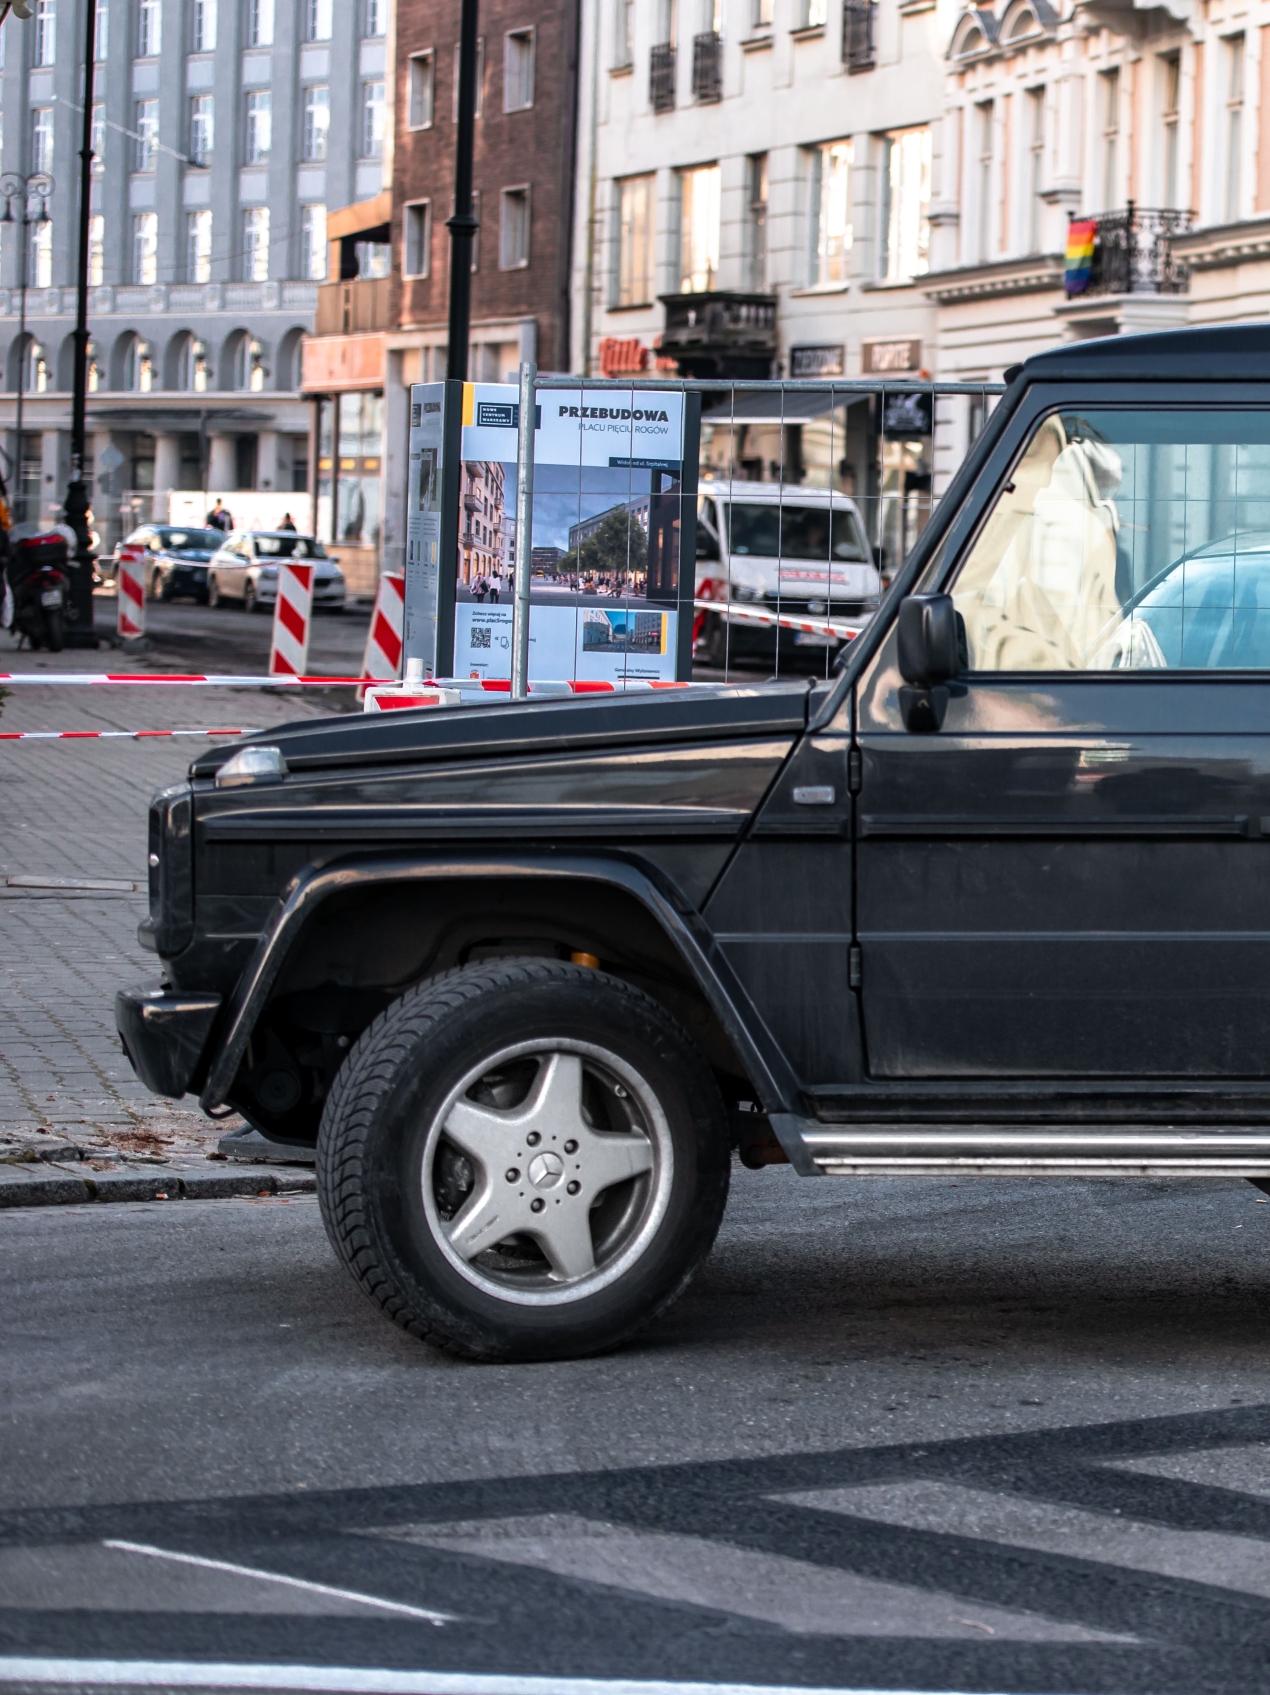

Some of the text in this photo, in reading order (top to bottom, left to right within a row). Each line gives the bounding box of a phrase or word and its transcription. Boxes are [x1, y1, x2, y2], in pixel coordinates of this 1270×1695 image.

[558, 405, 669, 422] PRZEBUDOWA
[578, 423, 669, 435] PLACU PIĘCIU ROGÓW
